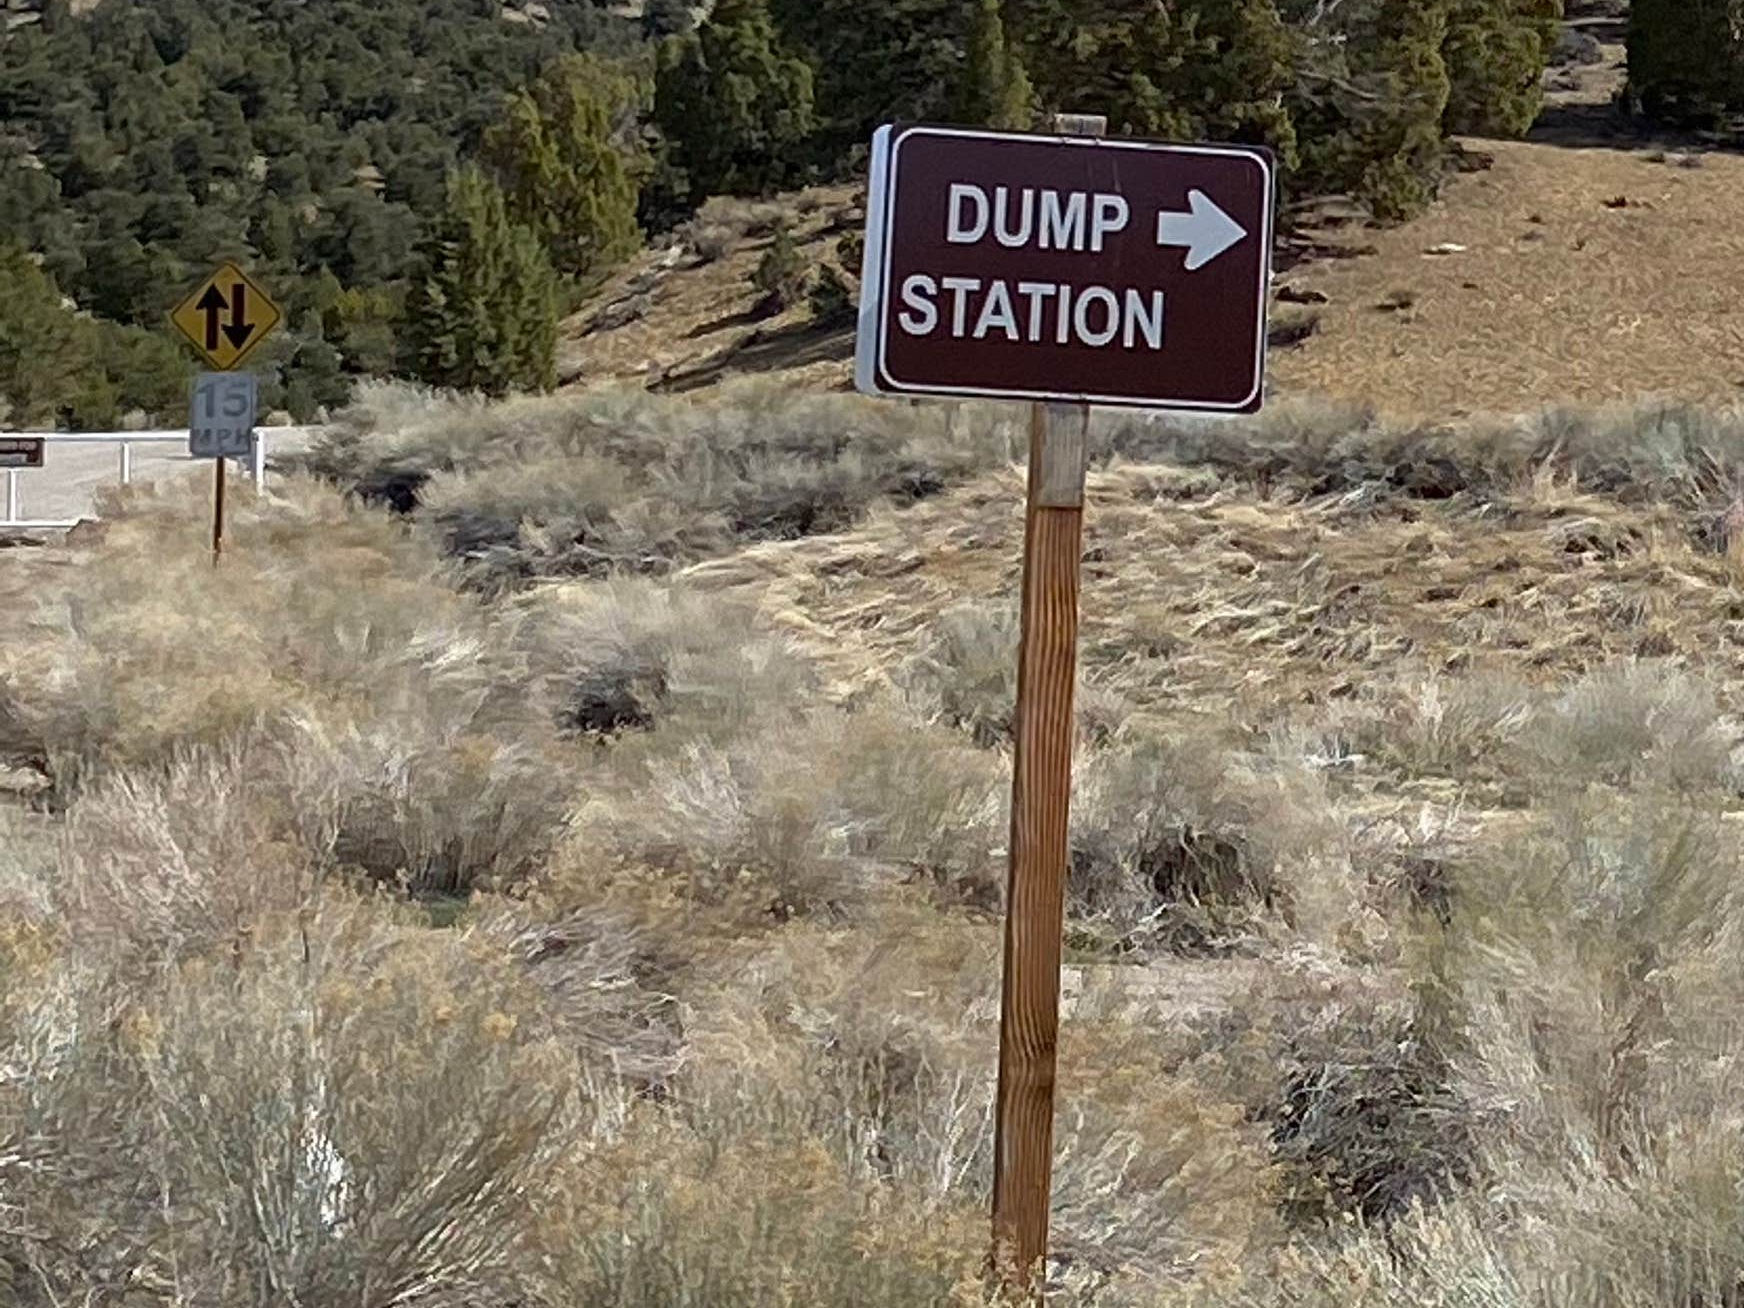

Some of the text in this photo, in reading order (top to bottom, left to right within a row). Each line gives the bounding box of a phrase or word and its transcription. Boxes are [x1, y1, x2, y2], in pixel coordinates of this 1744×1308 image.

[947, 183, 1129, 252] DUMP
[899, 275, 1164, 350] STATION
[198, 380, 249, 418] 15
